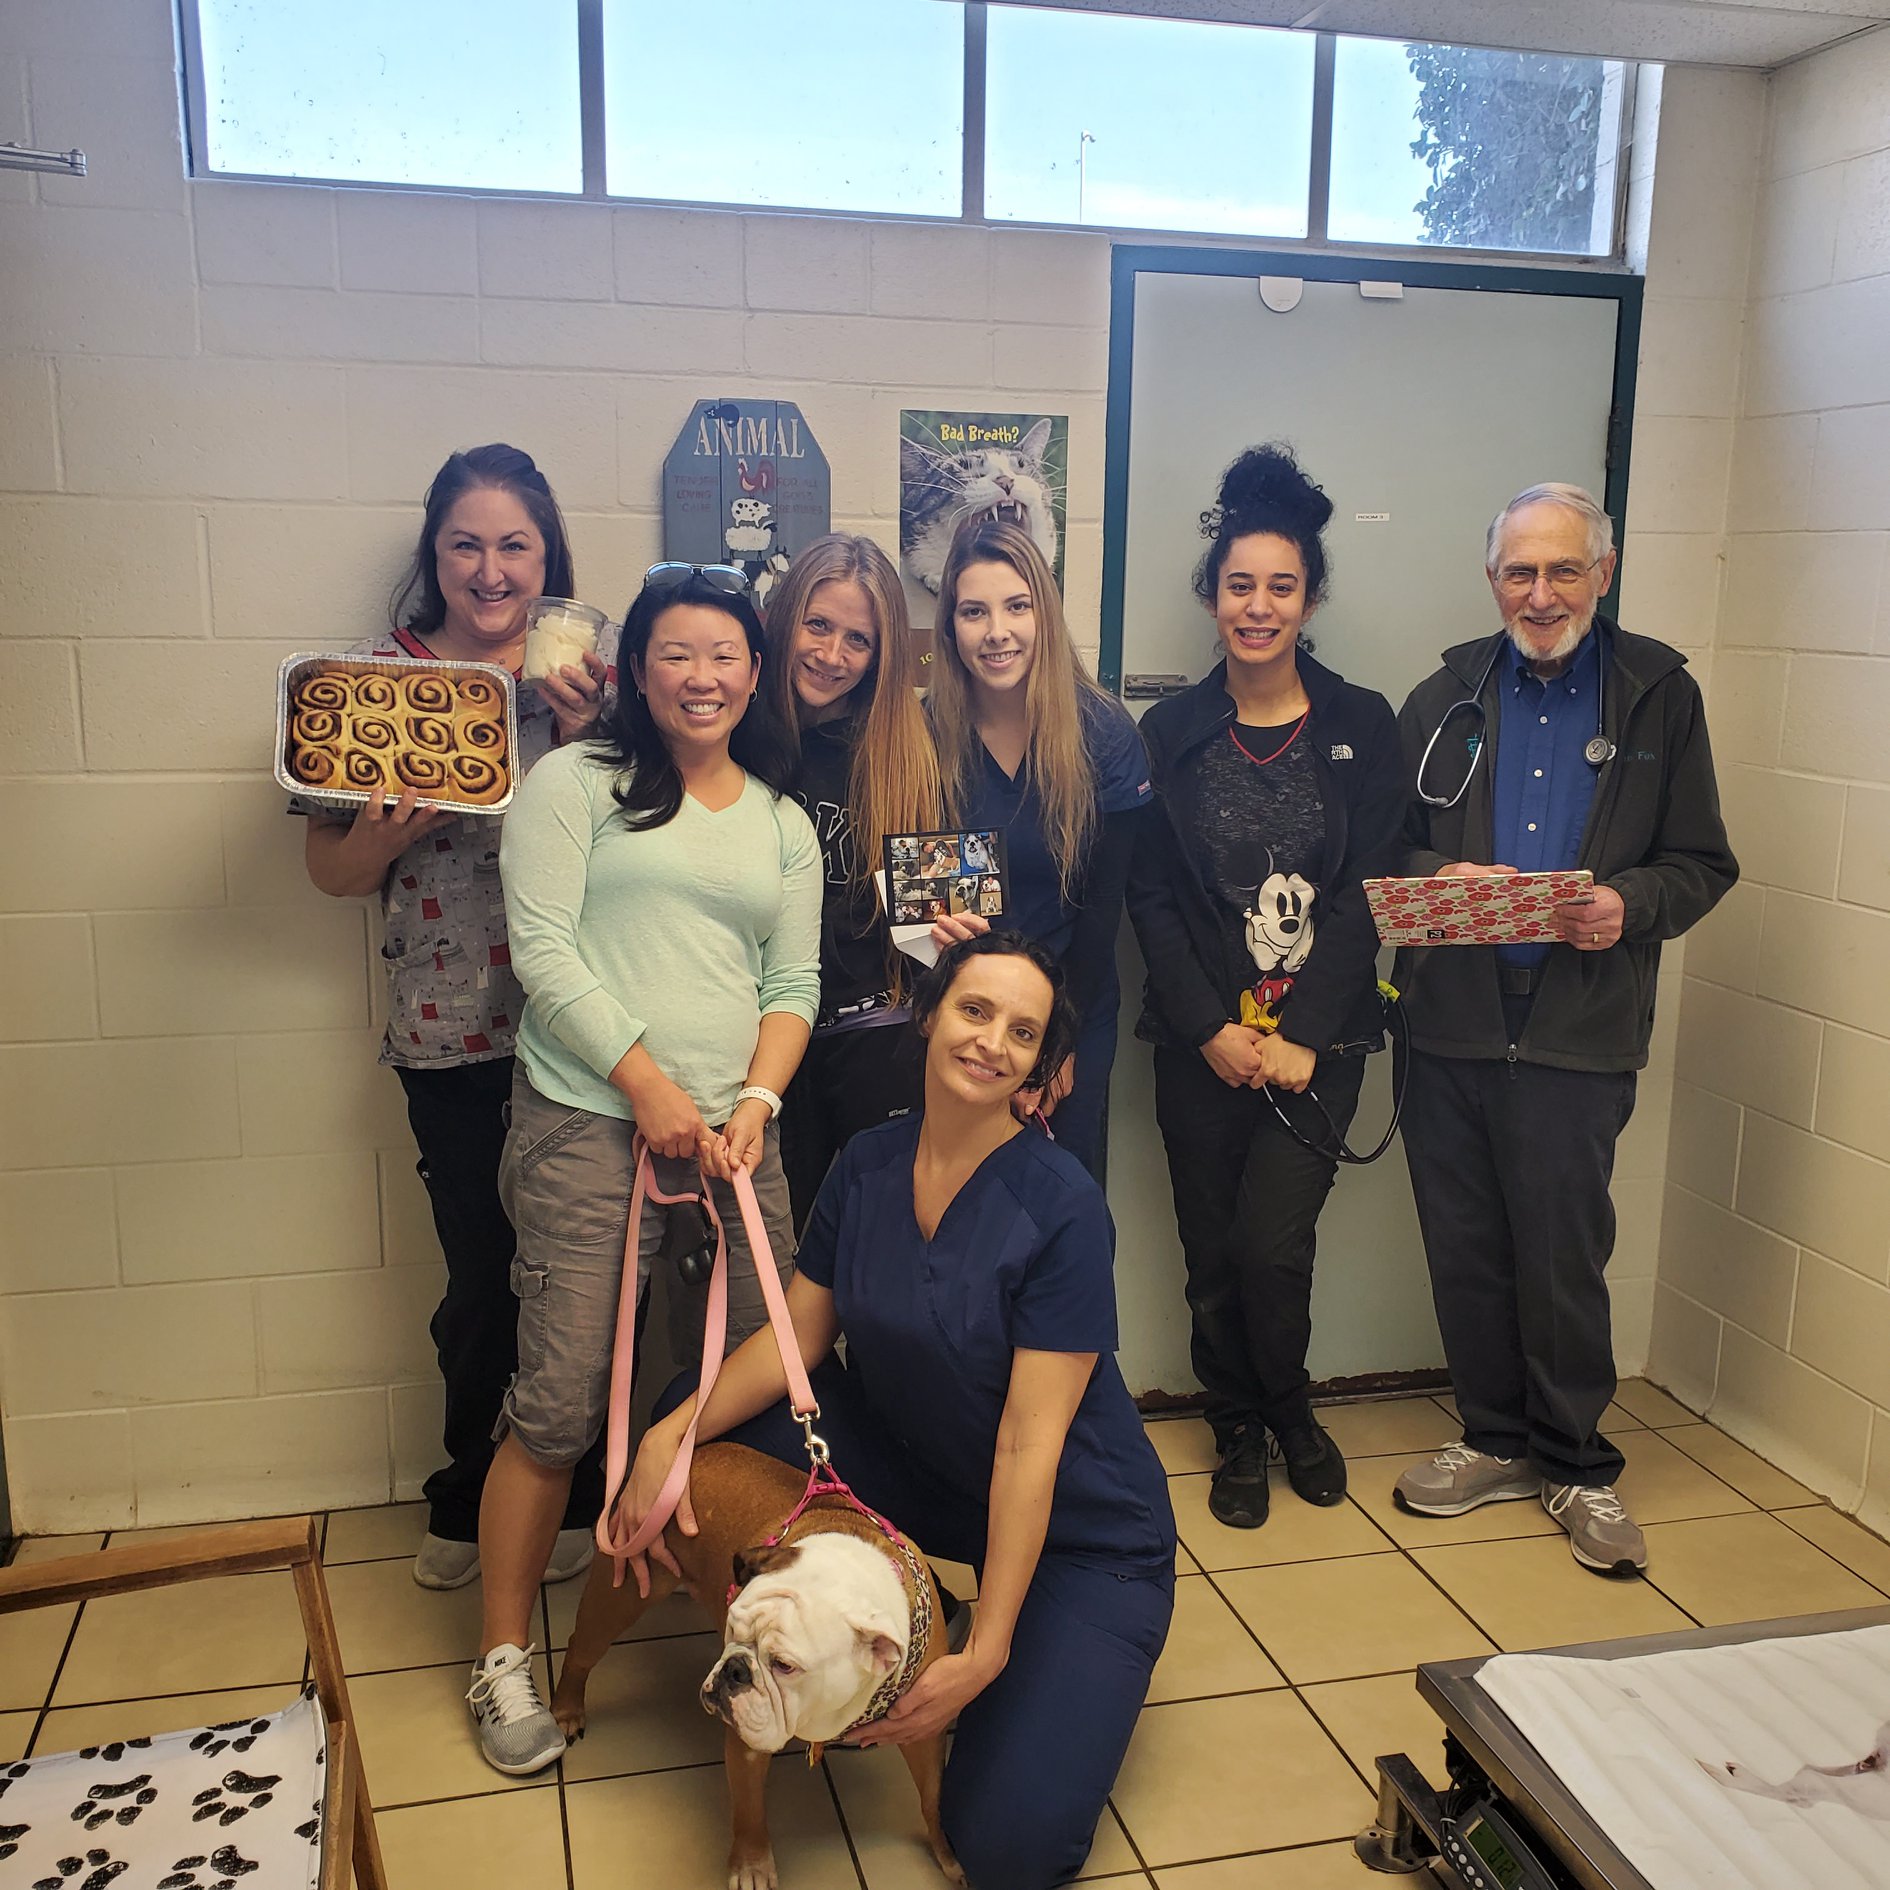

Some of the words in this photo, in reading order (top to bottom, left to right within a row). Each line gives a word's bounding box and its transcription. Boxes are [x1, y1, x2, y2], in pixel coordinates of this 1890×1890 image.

[693, 416, 805, 458] ANIMAL
[940, 423, 965, 441] Bad
[968, 425, 1019, 443] Breath?
[494, 1656, 506, 1668] NIKE
